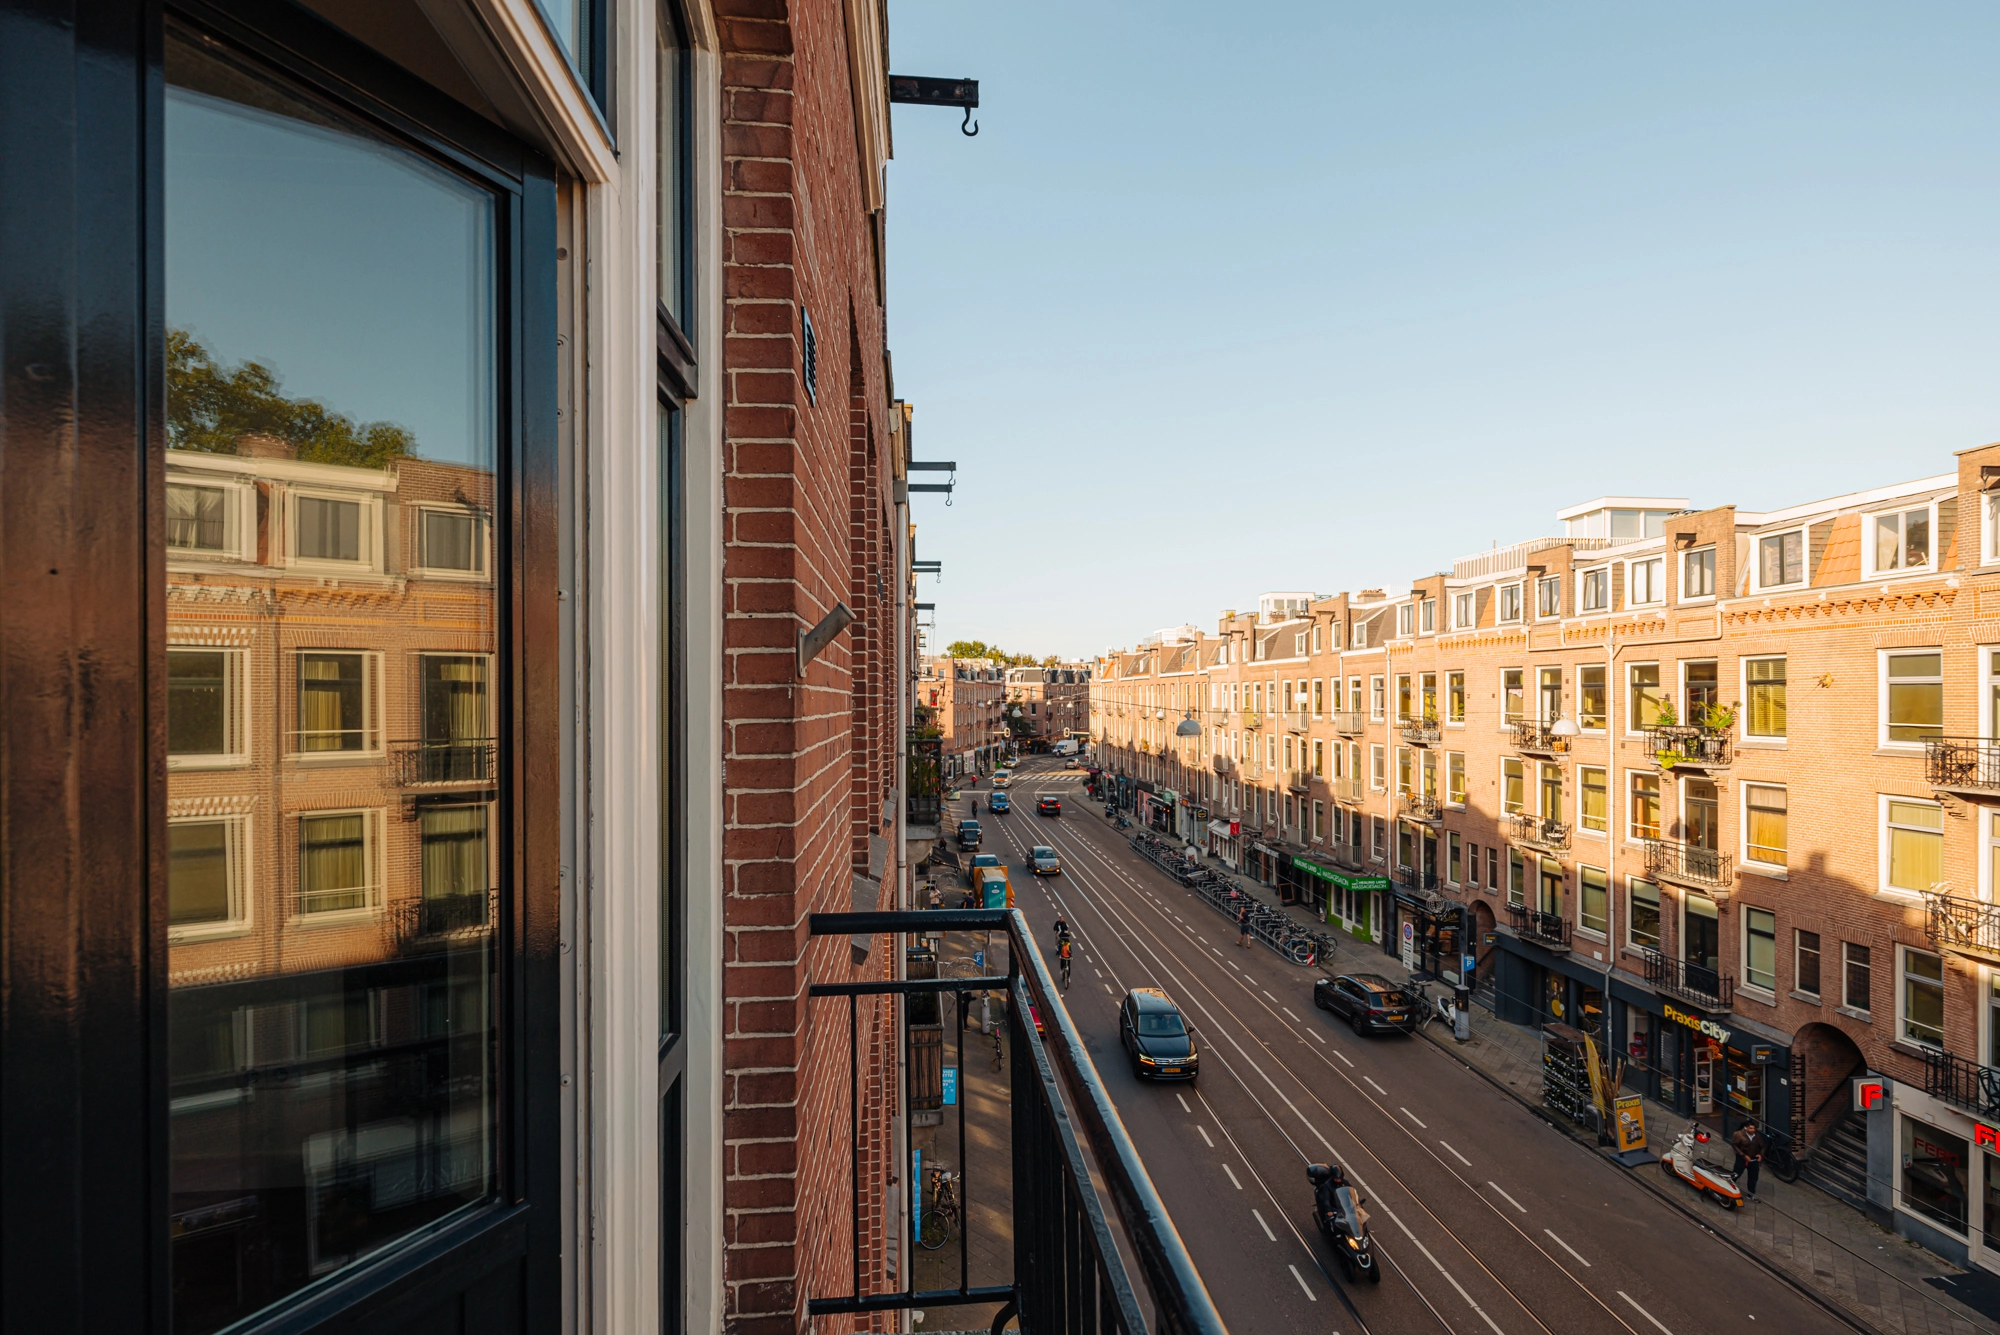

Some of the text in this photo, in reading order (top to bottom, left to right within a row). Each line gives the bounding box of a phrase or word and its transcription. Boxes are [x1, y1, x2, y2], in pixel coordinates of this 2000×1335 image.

[1616, 1098, 1640, 1109] Praxis
[1859, 1082, 1882, 1109] F
[1914, 1137, 1959, 1167] FEBO
